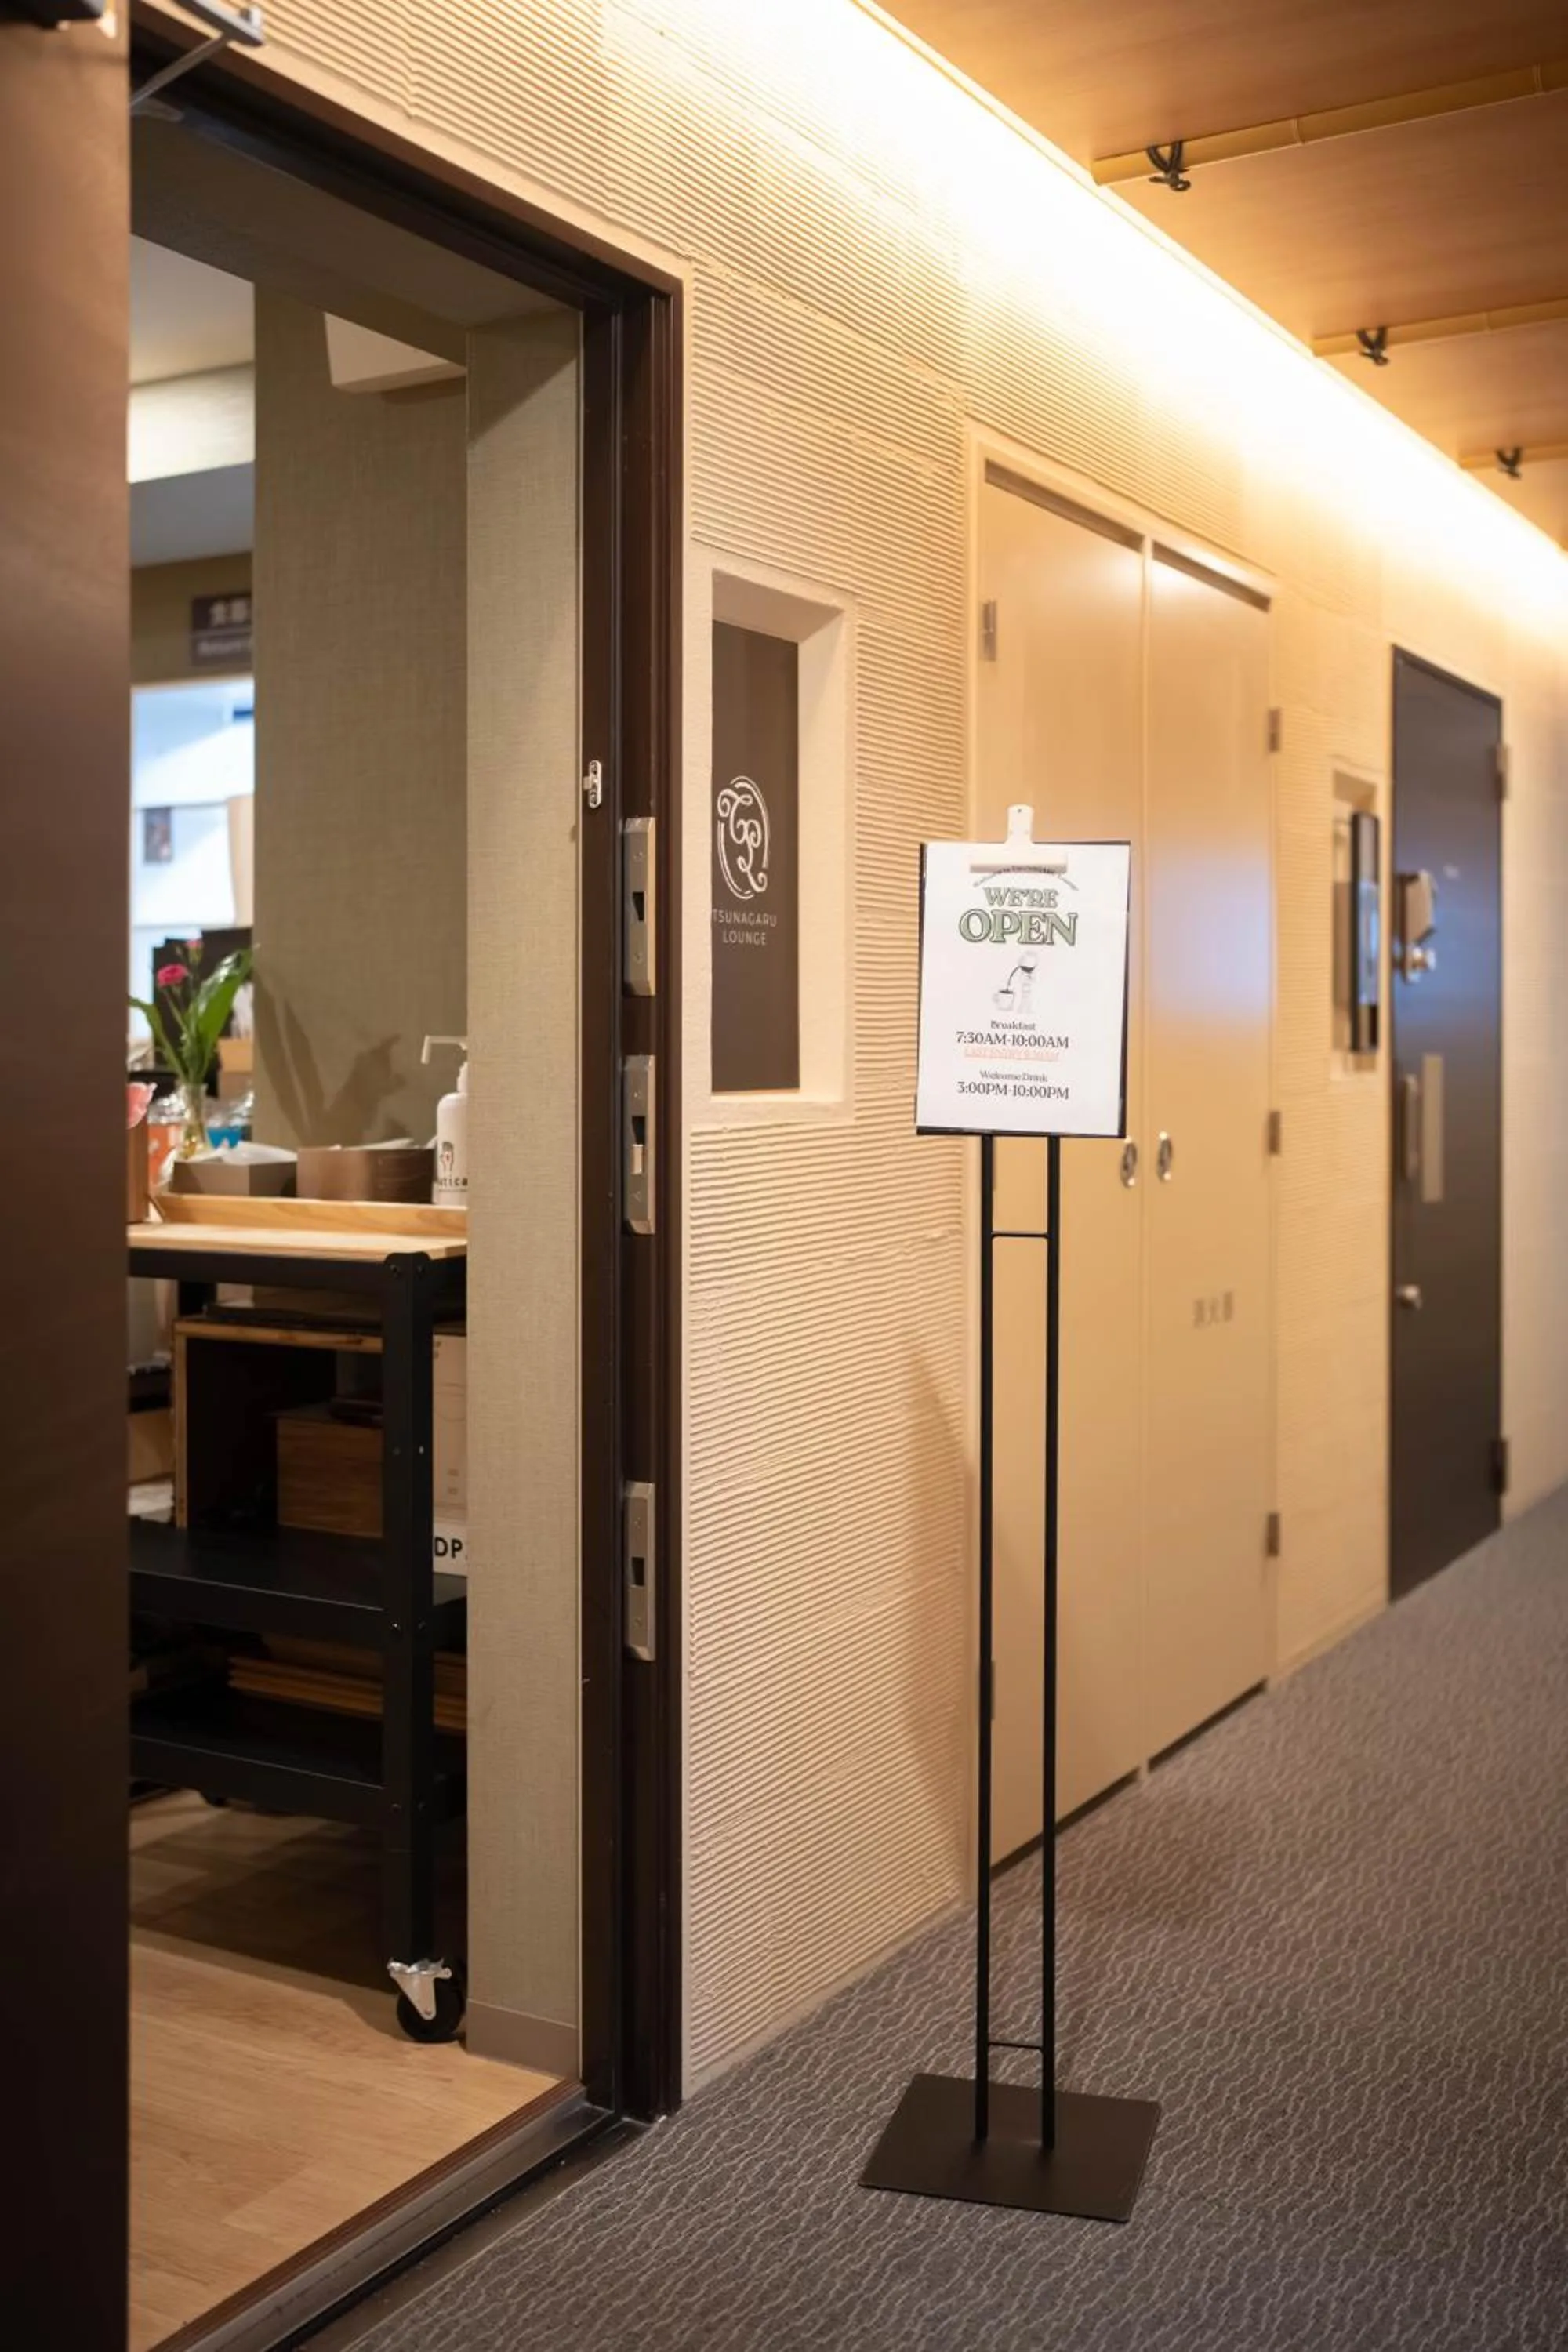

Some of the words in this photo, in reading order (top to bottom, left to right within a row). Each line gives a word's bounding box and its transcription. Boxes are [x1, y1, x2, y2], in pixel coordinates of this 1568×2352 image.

[982, 887, 1058, 908] WE'RE
[712, 909, 777, 927] TSUNAGARU
[959, 909, 1079, 946] OPEN
[723, 930, 767, 946] LOUNGE
[990, 1020, 1036, 1031] Breakfast
[956, 1031, 1069, 1049] 7:30AM-10:00AM
[980, 1070, 1022, 1080] Welcome
[1022, 1072, 1048, 1082] Drink
[956, 1081, 1069, 1100] 3:00PM-10:00PM
